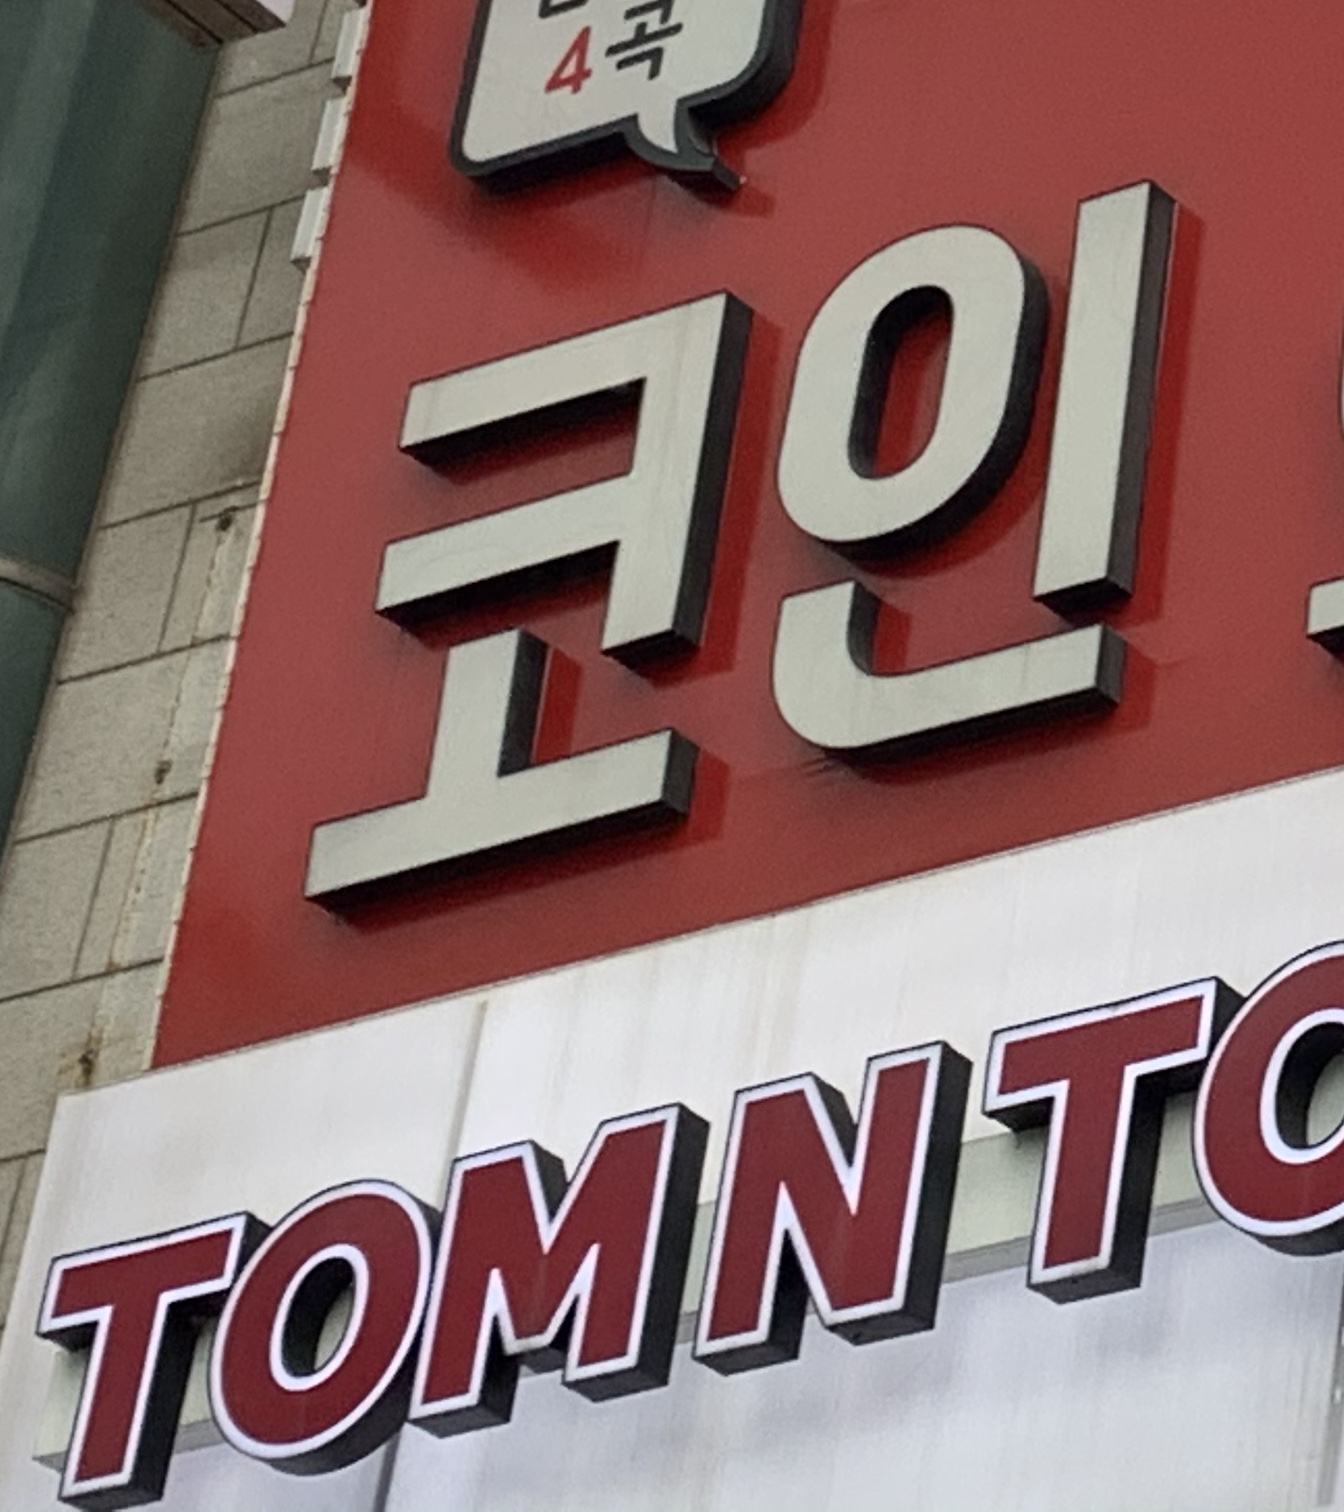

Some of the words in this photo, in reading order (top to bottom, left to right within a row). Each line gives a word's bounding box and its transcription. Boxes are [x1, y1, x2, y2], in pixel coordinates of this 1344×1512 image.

[305, 180, 1176, 913] 코인
[36, 1100, 708, 1510] TOM
[694, 1039, 972, 1372] N
